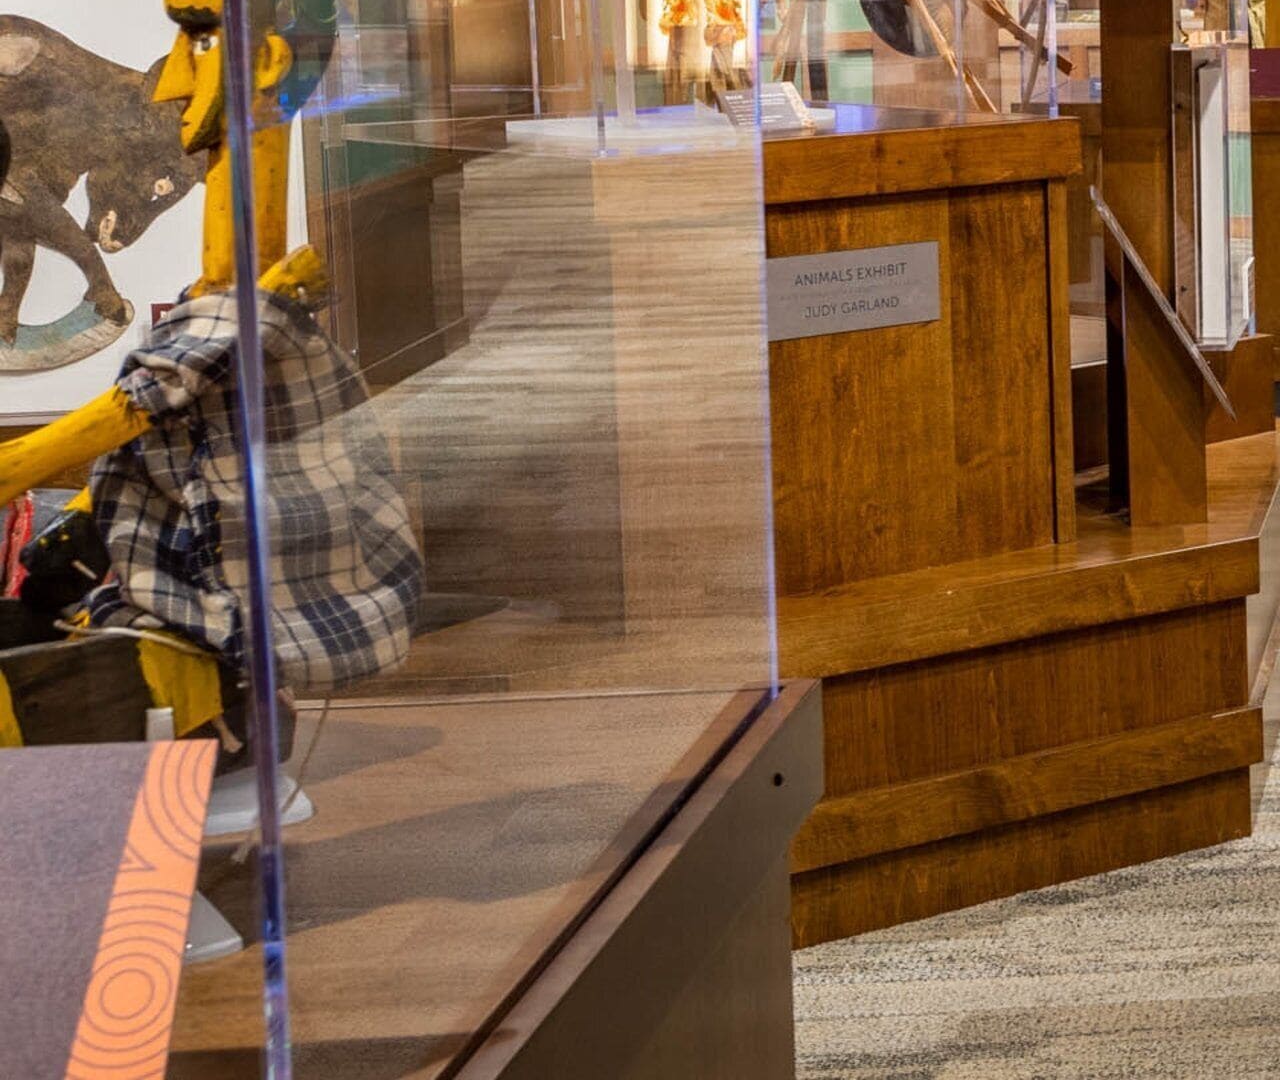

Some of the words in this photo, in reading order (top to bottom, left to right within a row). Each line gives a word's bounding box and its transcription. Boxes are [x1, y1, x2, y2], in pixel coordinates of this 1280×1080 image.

[794, 267, 853, 287] ANIMALS
[857, 262, 907, 279] EXHIBIT
[804, 305, 837, 319] JUDY
[840, 296, 900, 314] GARLAND
